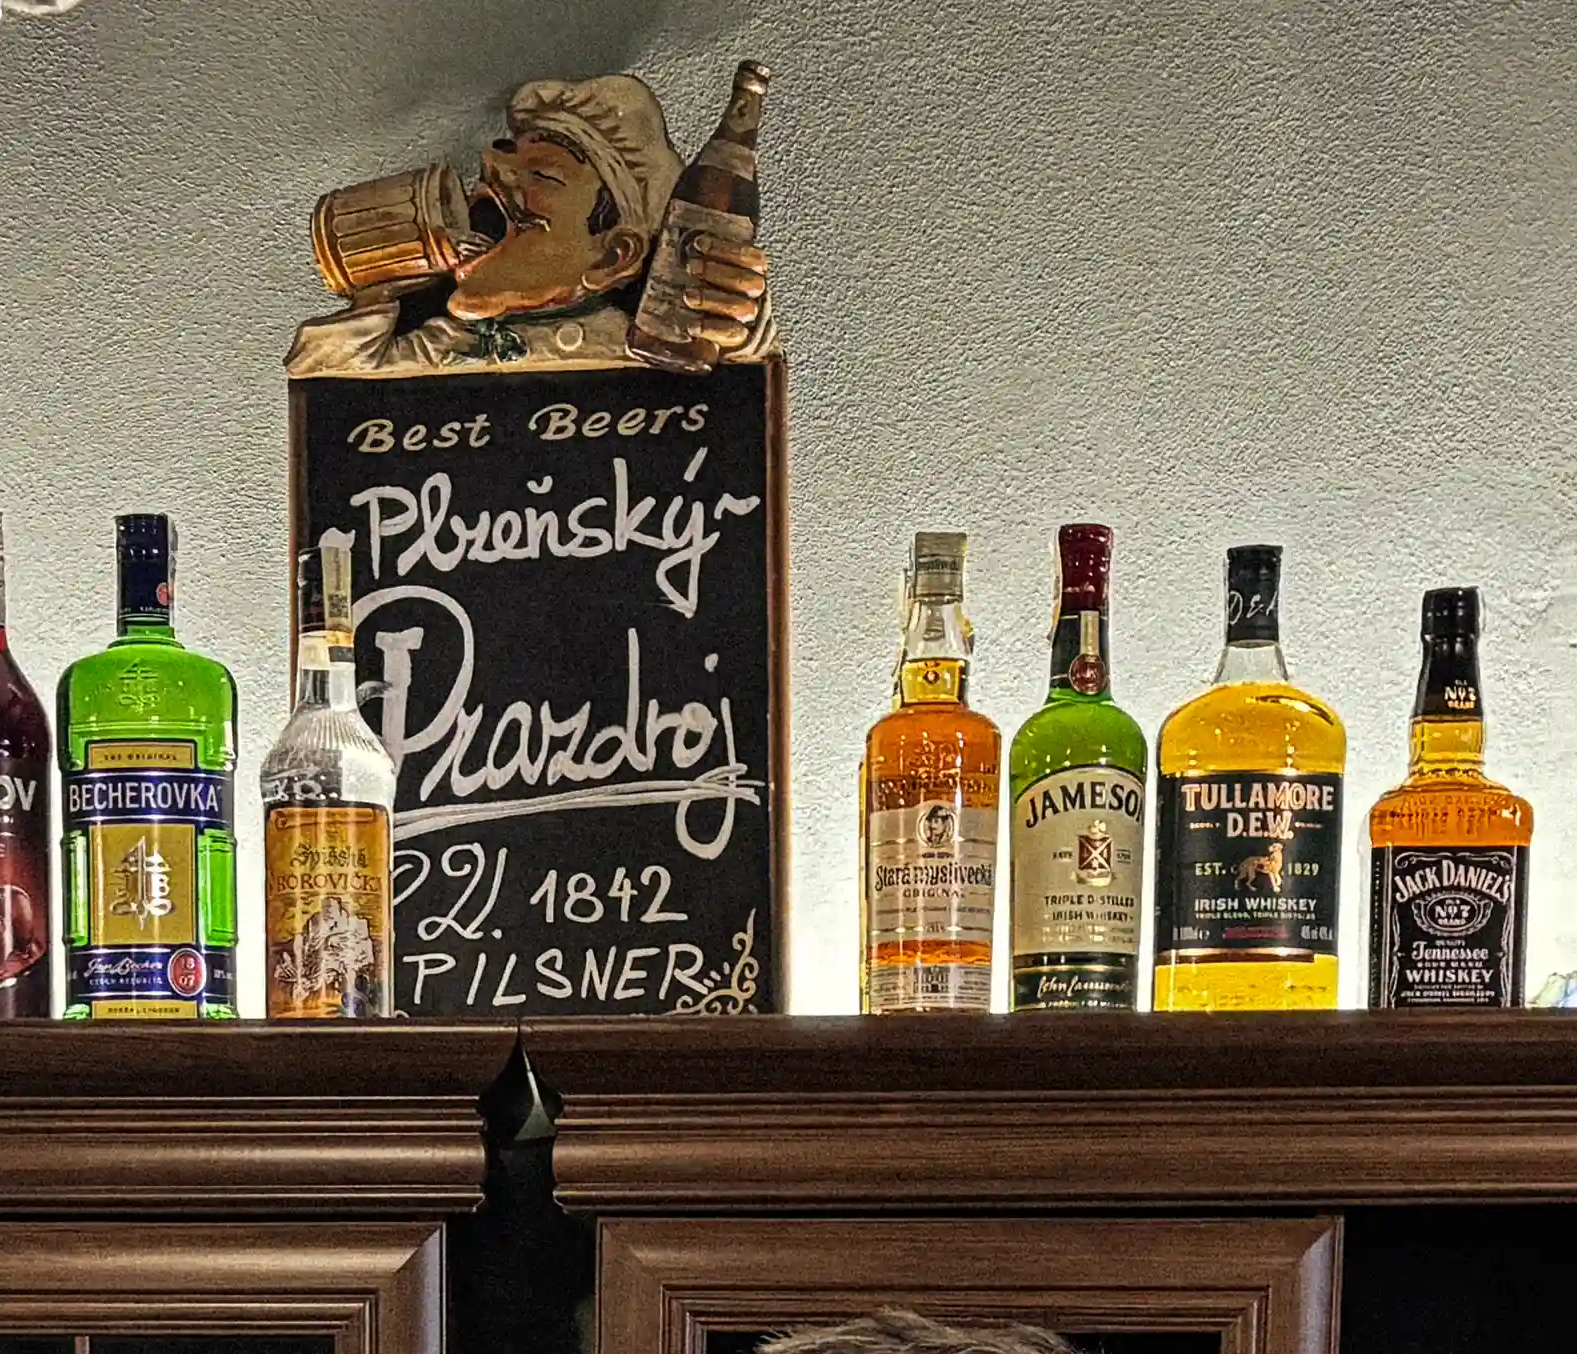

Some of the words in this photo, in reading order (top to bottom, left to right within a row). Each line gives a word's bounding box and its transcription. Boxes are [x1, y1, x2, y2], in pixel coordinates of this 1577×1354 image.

[347, 413, 491, 452] Best
[529, 402, 708, 441] Beers
[353, 585, 748, 859] Prazdroj
[69, 781, 219, 813] BECHEROVKA
[1181, 782, 1334, 811] TULLAMORE
[1226, 811, 1293, 839] D.E.W.
[875, 863, 911, 891] Stará
[1195, 862, 1226, 876] EST.
[1288, 863, 1319, 876] 1829
[530, 865, 689, 922] 1842
[1394, 866, 1441, 902] JACK
[1044, 895, 1083, 907] TRIPLE
[1194, 898, 1239, 911] IRISH
[1245, 898, 1317, 911] WHISKEY
[1412, 941, 1489, 960] Tennessee
[403, 944, 709, 1005] PILSNER
[1406, 969, 1494, 983] WHISKEY
